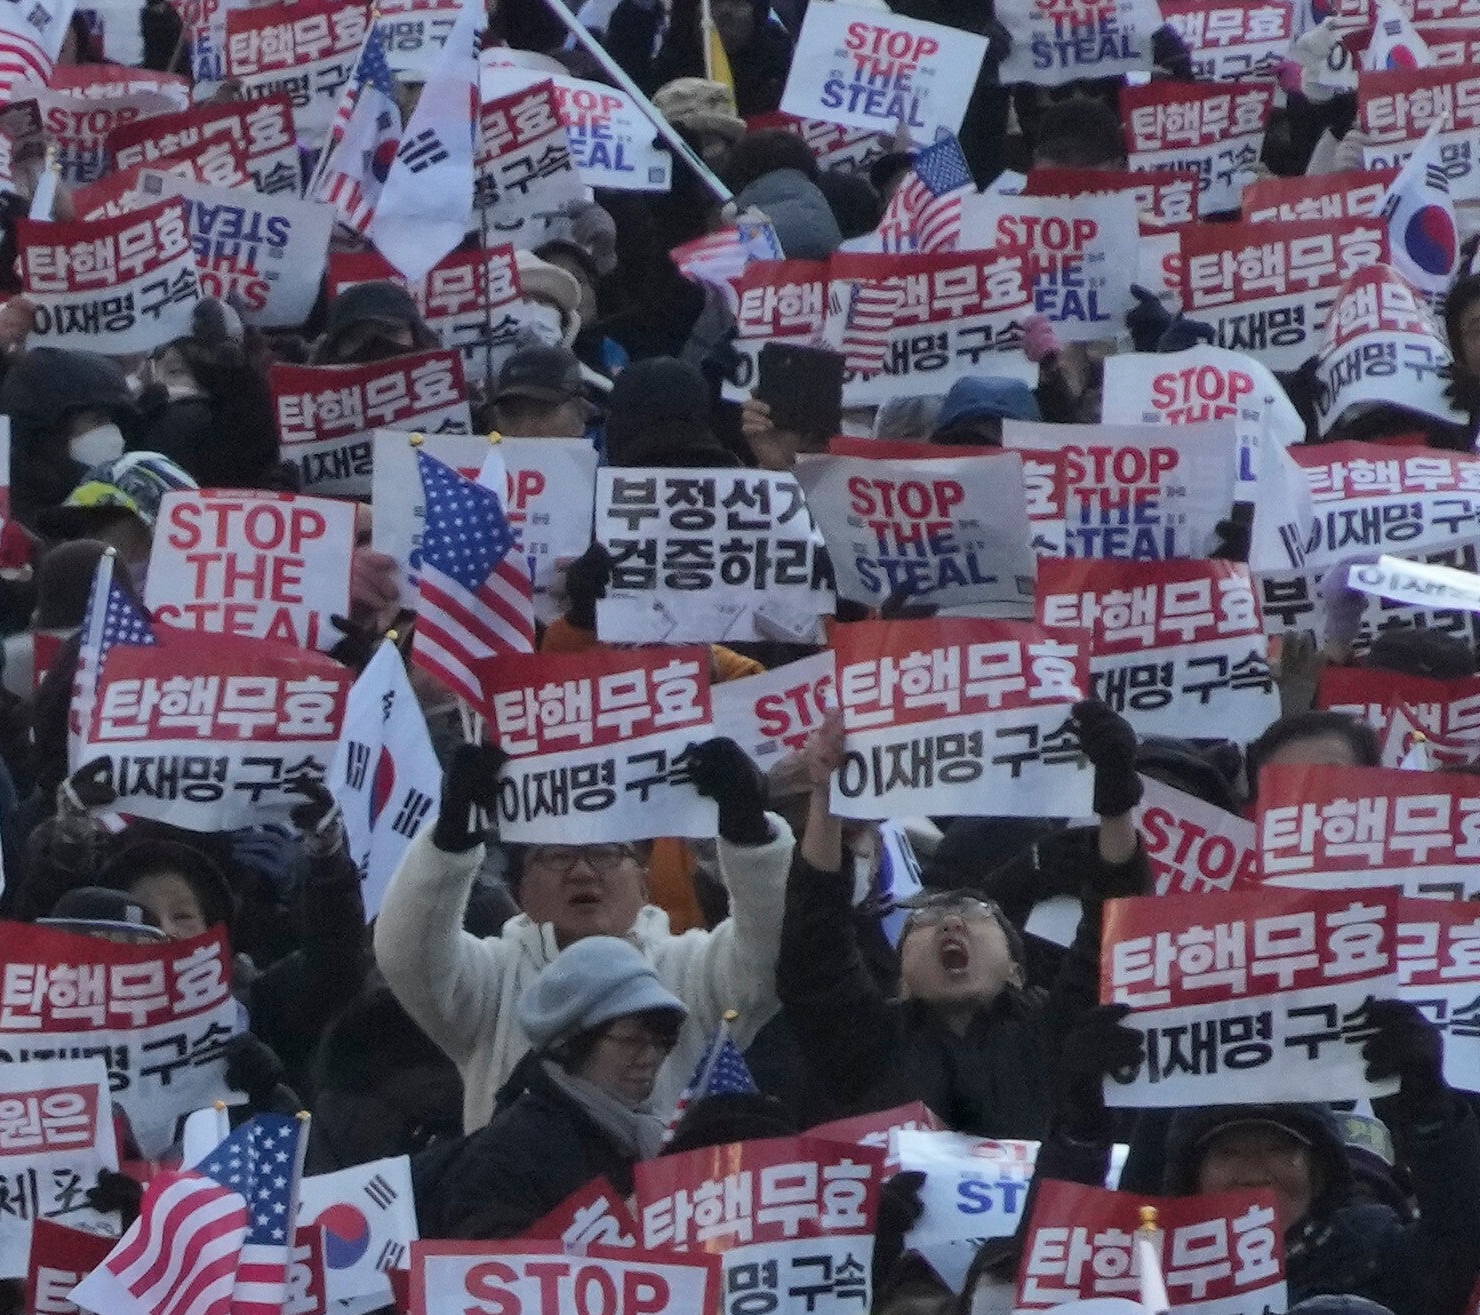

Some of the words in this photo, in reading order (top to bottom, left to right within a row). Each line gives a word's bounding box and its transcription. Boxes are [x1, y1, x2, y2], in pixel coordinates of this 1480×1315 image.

[843, 22, 939, 64] STOP
[849, 55, 916, 90] THE
[820, 77, 927, 129] STEAL
[24, 209, 190, 291] 탄핵무효
[1187, 230, 1384, 305] 탄핵무효
[847, 477, 963, 520] STOP
[167, 502, 327, 552] STOP
[867, 516, 957, 555] THE
[187, 553, 304, 602] THE
[855, 551, 997, 598] STEAL
[843, 633, 1083, 723] 탄핵무효
[102, 673, 341, 742] 탄핵무효
[496, 660, 703, 755] 탄핵무효
[1111, 902, 1396, 1007] 탄핵무효
